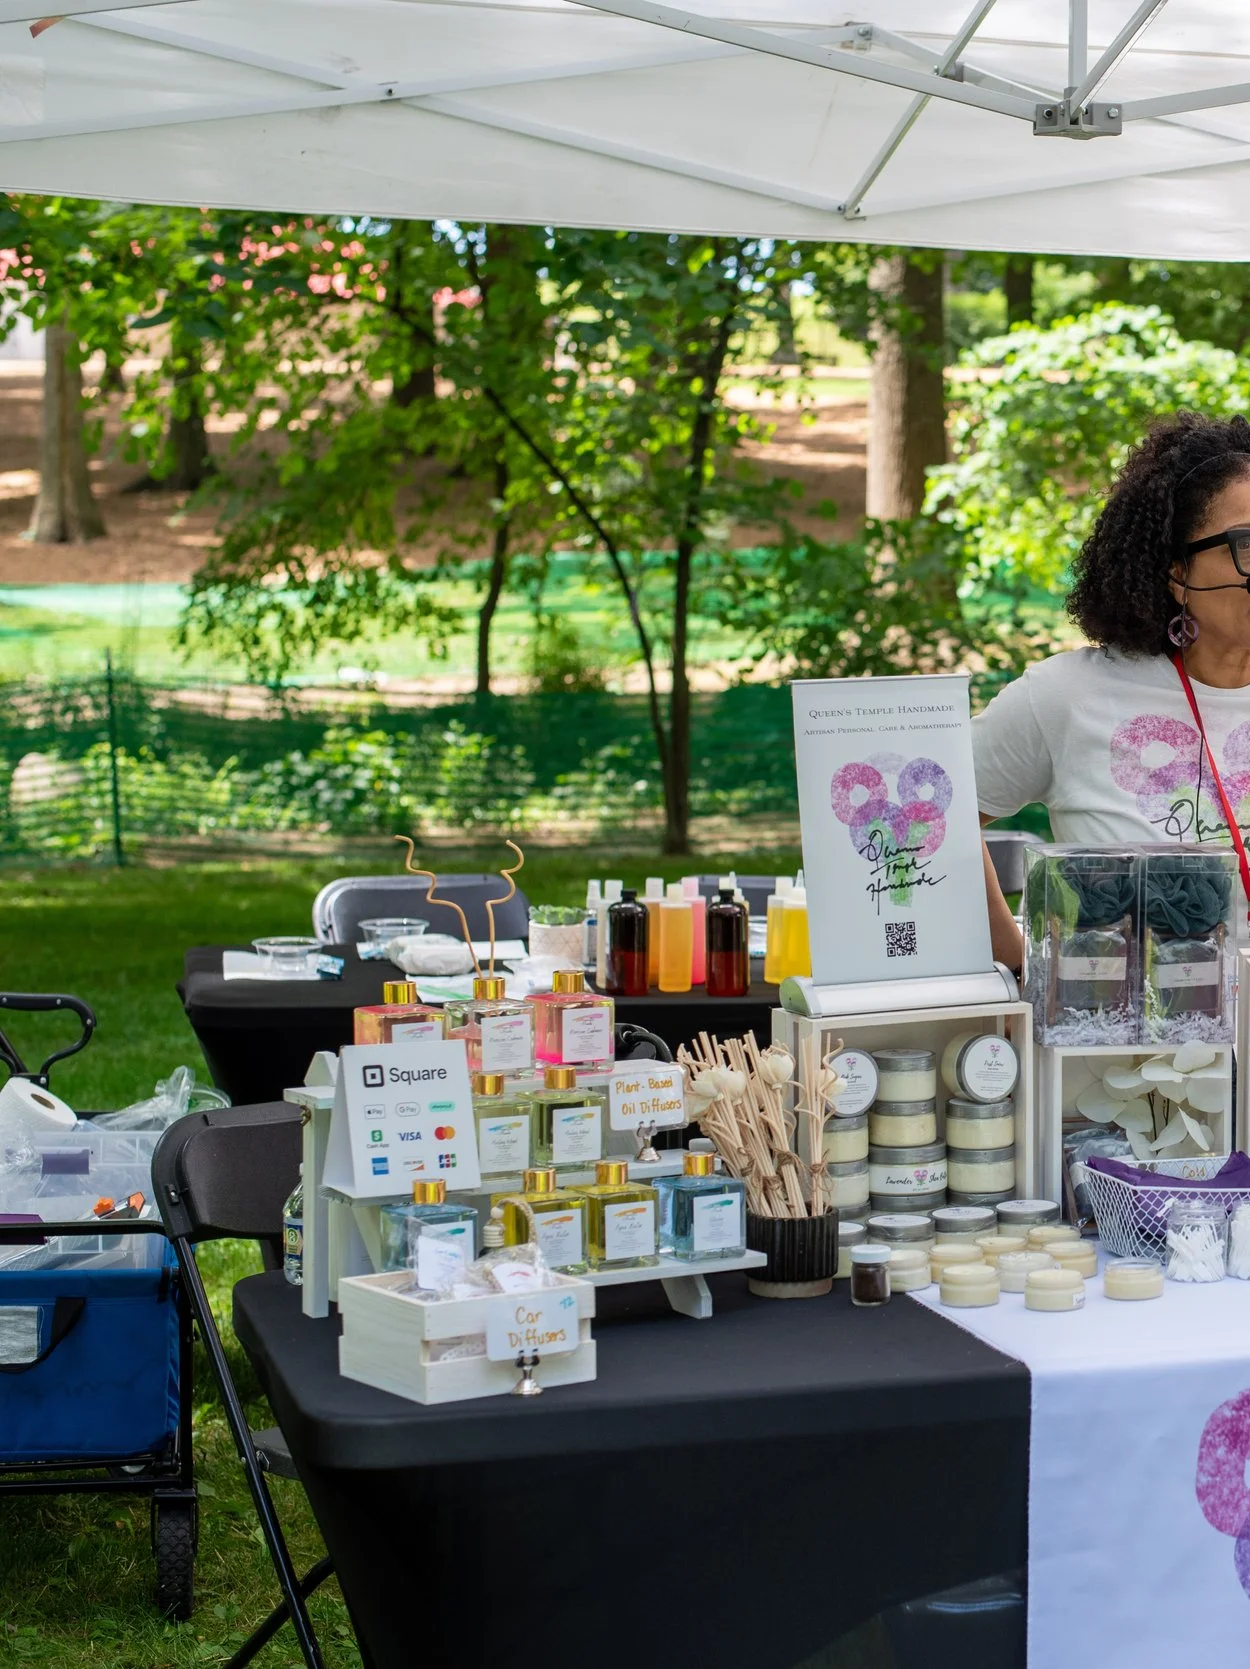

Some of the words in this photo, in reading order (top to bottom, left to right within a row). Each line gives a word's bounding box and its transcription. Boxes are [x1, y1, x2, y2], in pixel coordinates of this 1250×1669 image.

[389, 1067, 447, 1085] Square
[622, 1102, 636, 1115] Oil
[640, 1098, 682, 1115] Diffusers
[397, 1131, 422, 1141] VISA
[515, 1306, 543, 1325] Car
[507, 1328, 567, 1348] Diffusers
